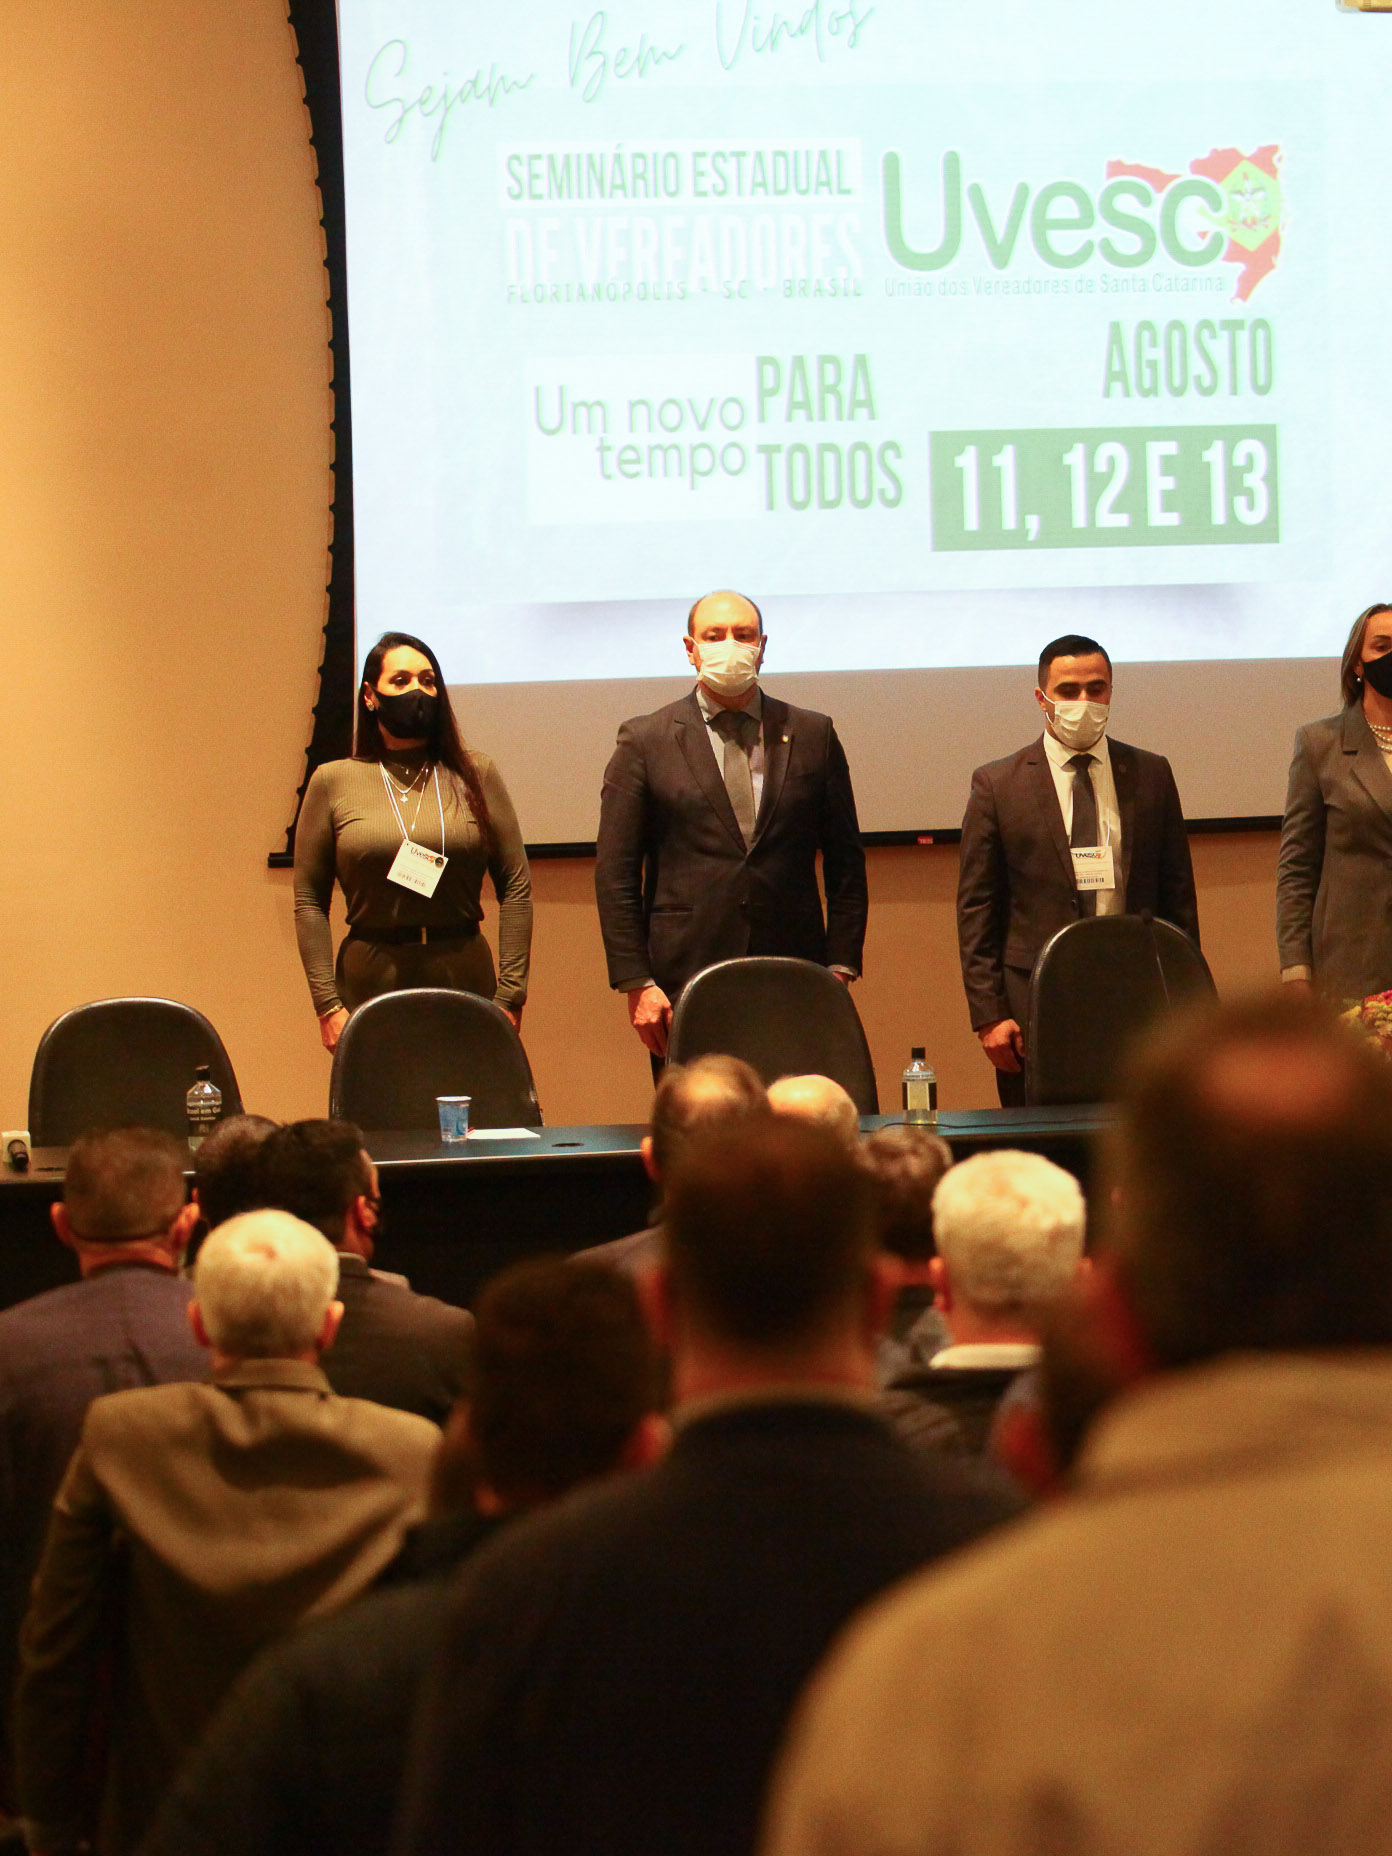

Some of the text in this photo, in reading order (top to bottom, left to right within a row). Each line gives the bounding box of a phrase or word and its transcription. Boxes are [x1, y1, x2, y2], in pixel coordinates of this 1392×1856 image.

[365, 0, 876, 163] Sejam Bem Vindos
[506, 143, 854, 201] SEMINÁRIO ESTADUAL
[882, 148, 1226, 272] Uvesc
[506, 212, 864, 289] DE VEREADORES
[884, 271, 1226, 297] União dos Vereadores de Santa Catarina
[783, 278, 864, 299] BRASIL
[755, 353, 878, 424] PARA
[1102, 318, 1274, 399] AGOSTO
[532, 385, 746, 436] Um novo
[595, 434, 748, 491] tempo
[757, 440, 904, 512] TODOS
[953, 437, 1271, 543] 11, 12 E 13
